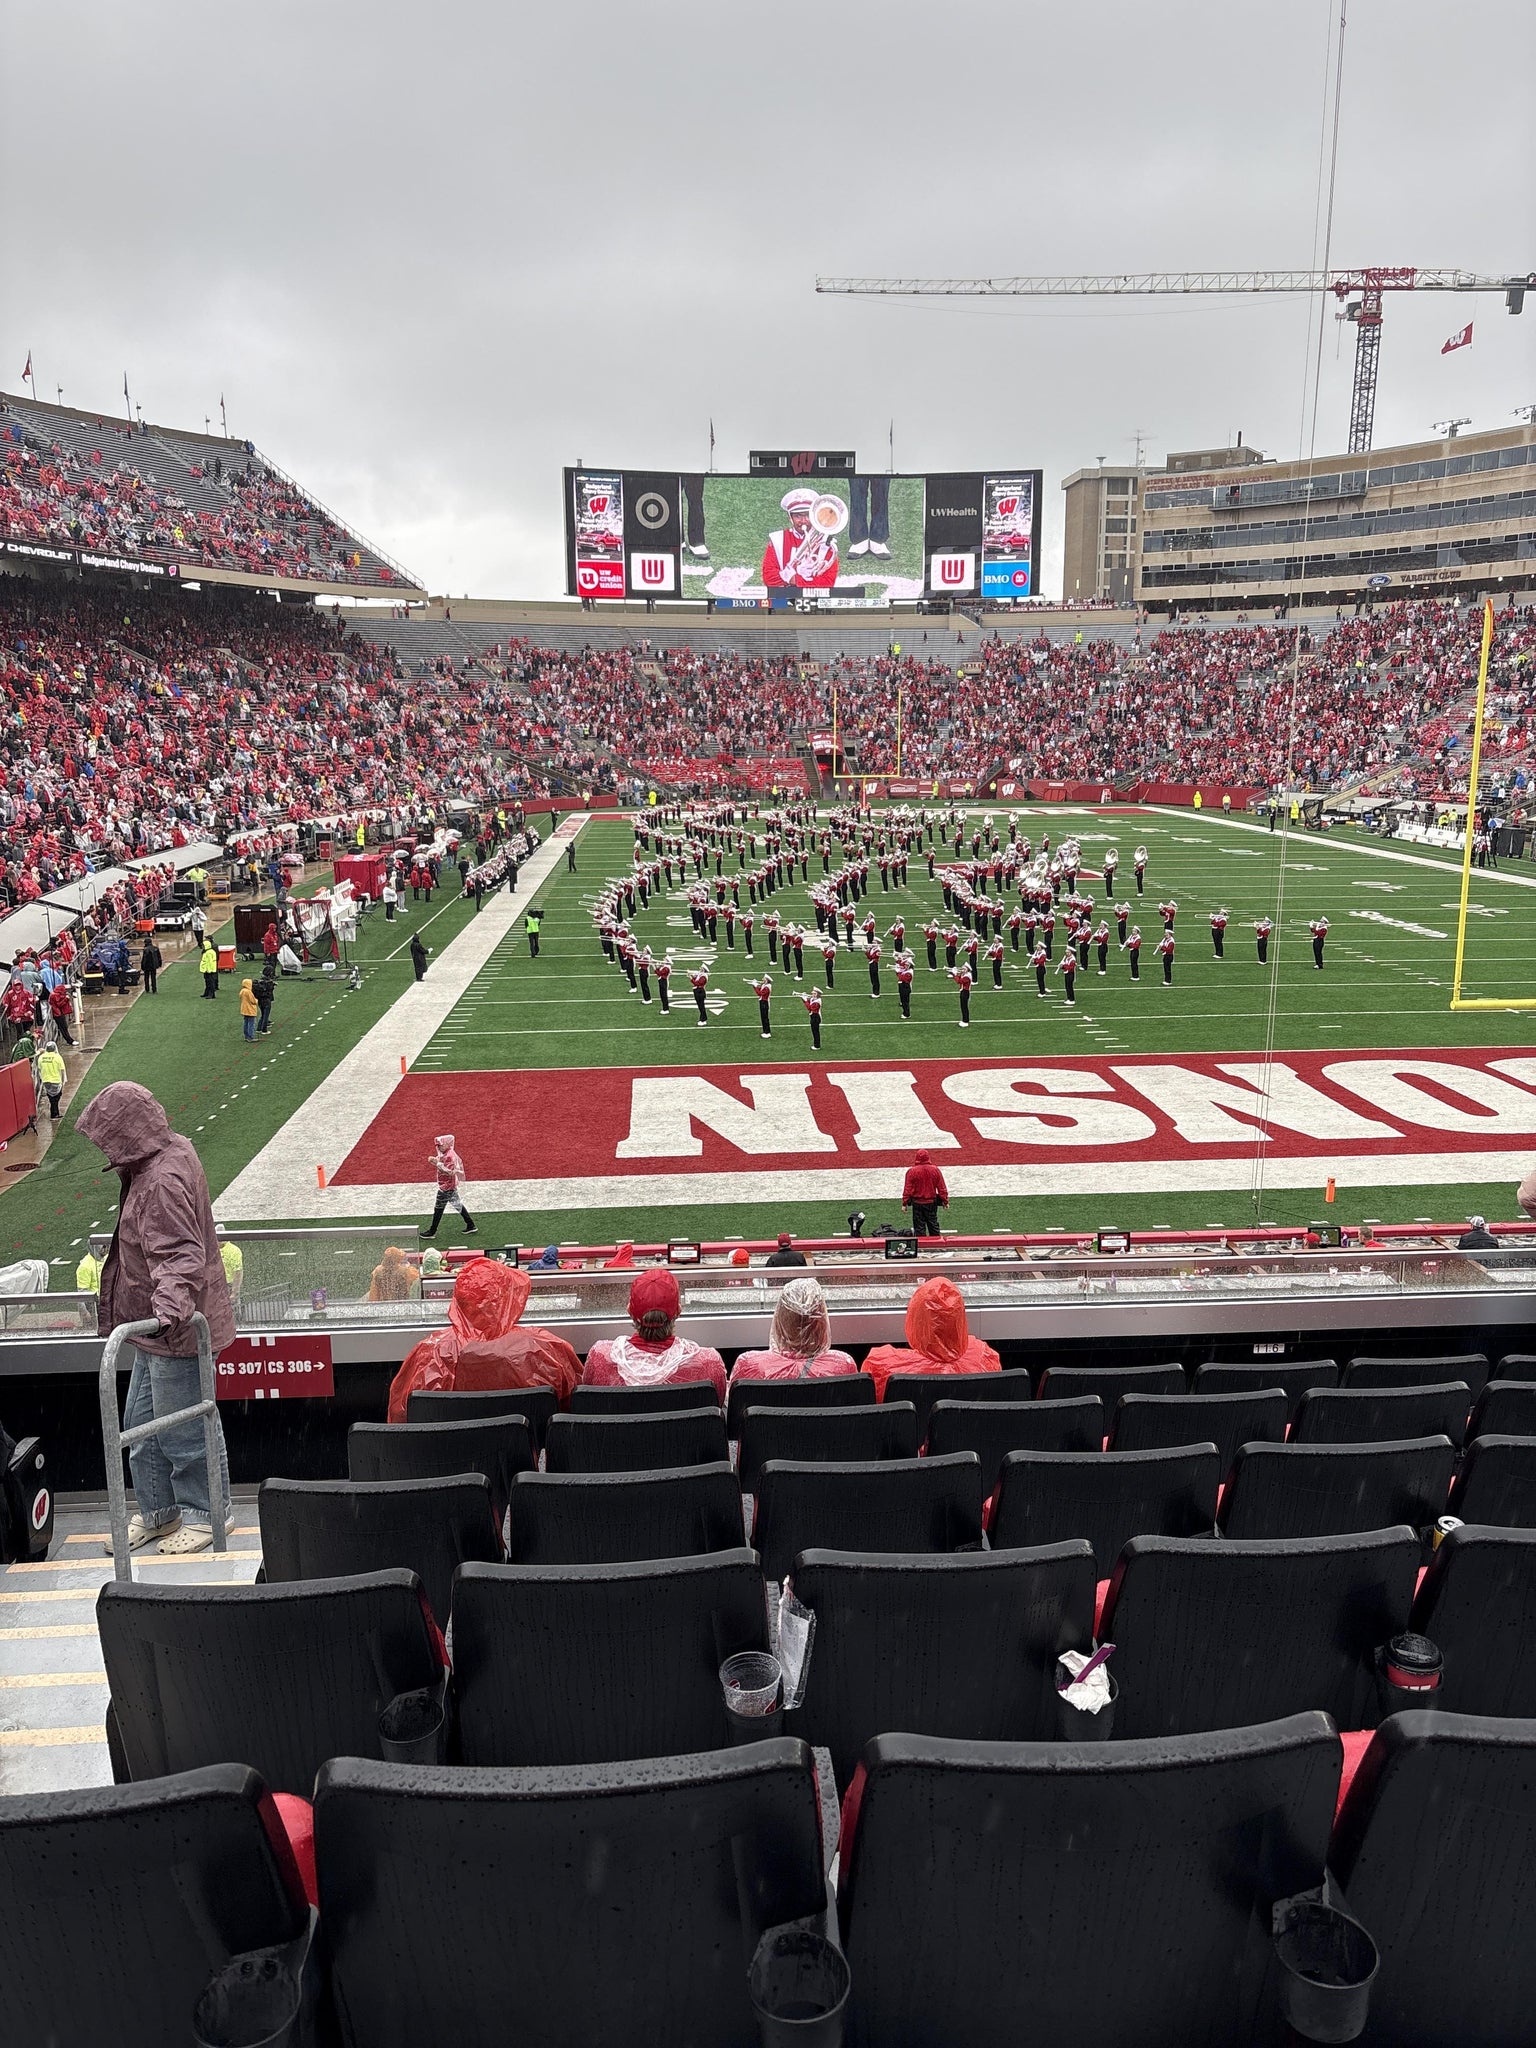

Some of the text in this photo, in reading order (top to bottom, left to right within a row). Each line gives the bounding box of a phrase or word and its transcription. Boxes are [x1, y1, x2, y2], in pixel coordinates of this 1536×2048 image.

[7, 543, 73, 561] CHEVROLET
[82, 553, 164, 574] Badgerland Chevy Dealers
[984, 574, 1009, 584] BMO
[1401, 571, 1461, 583] VARSITY CLUB
[732, 600, 756, 608] BMO
[219, 1360, 312, 1375] CS 307 CS 306
